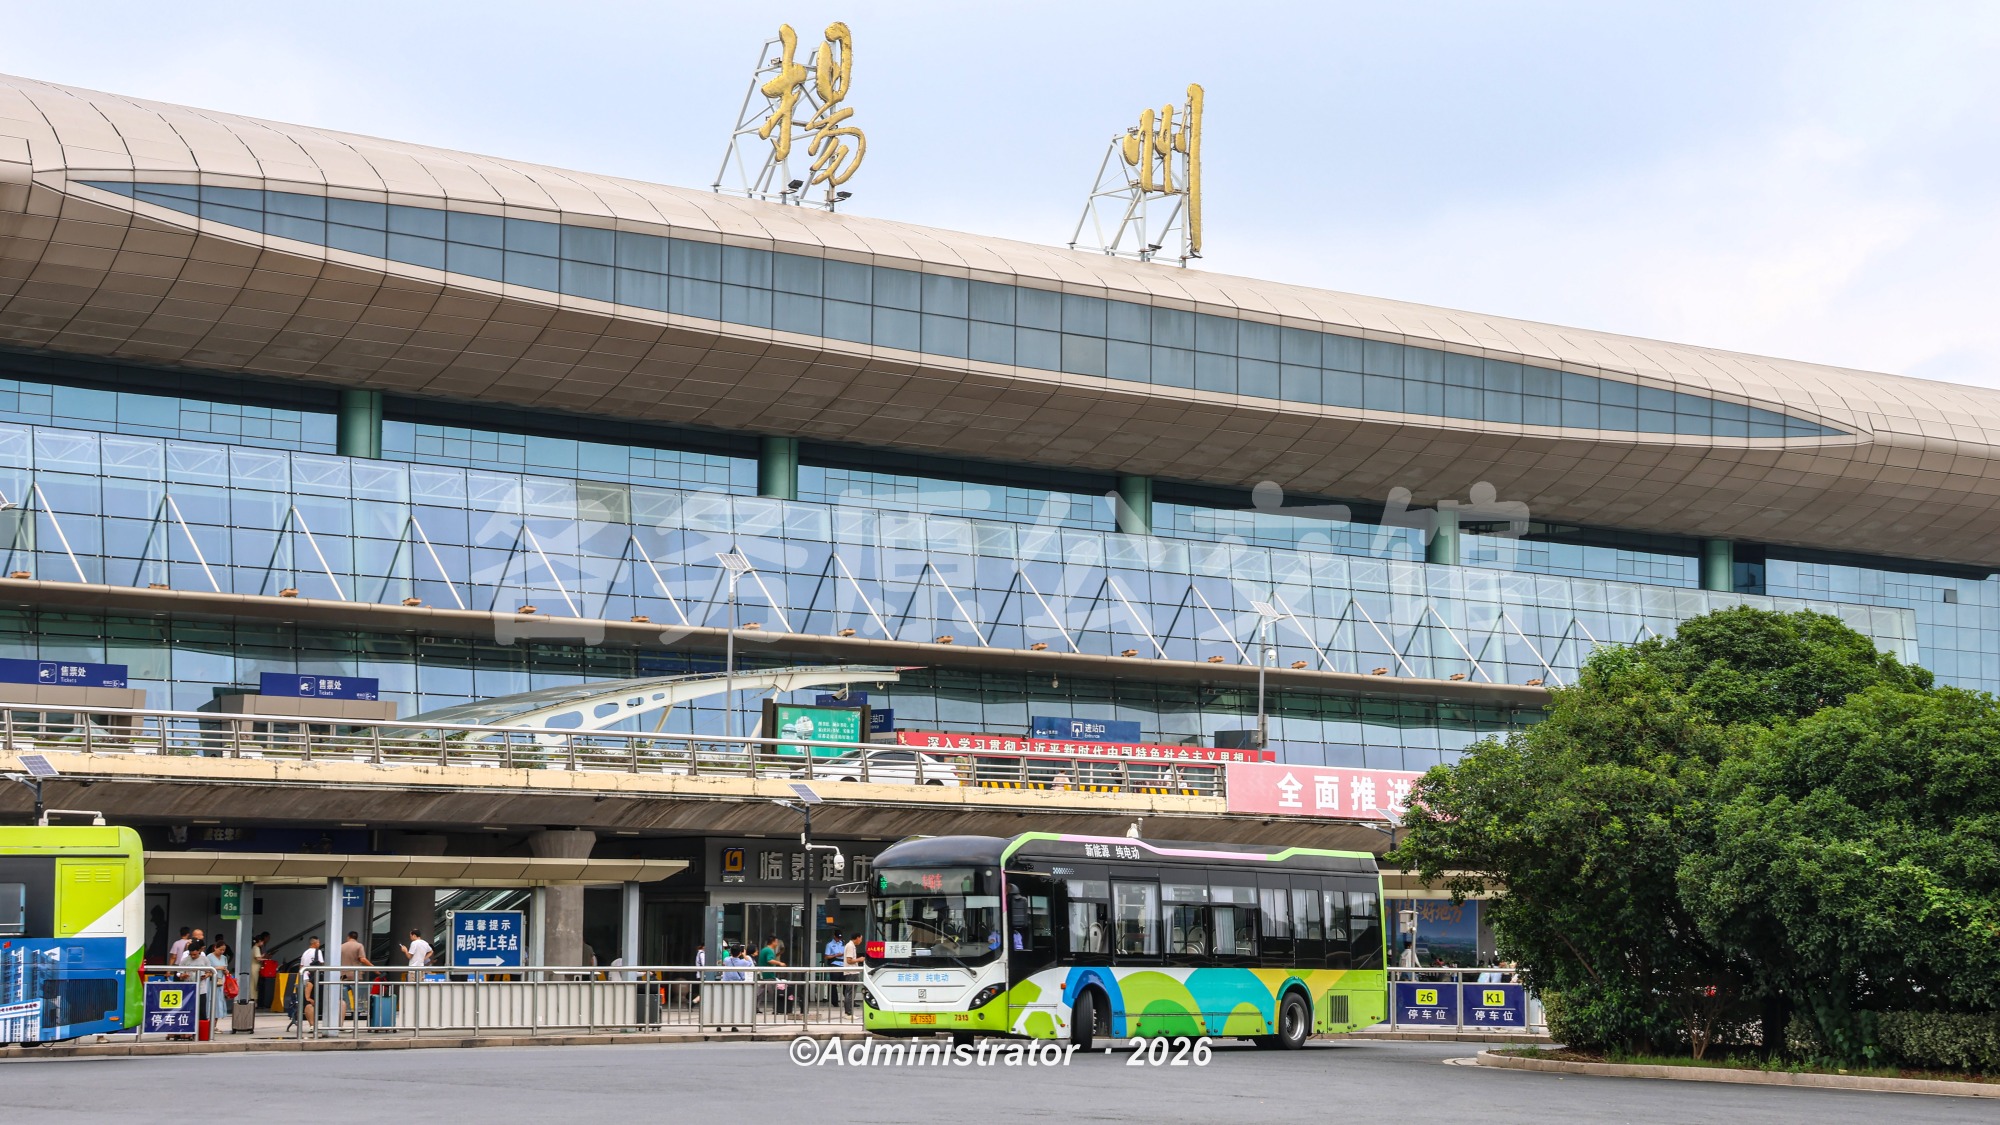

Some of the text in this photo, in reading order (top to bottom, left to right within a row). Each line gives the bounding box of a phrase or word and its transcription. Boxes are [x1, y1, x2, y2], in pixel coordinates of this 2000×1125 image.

[60, 665, 87, 677] 售票处
[60, 676, 77, 684] Tickets
[318, 679, 342, 690] 售票处
[1084, 723, 1105, 733] 进站口
[1085, 843, 1140, 860] 新能源 纯电动
[464, 919, 511, 931] 温馨提示
[456, 934, 518, 951] 网约车上车点
[897, 973, 949, 983] 新能源 纯电动
[163, 994, 179, 1006] 43
[1486, 993, 1502, 1004] K1
[150, 1013, 190, 1027] 停车位
[1407, 1009, 1447, 1021] 停车位
[1474, 1010, 1514, 1022] 停车位
